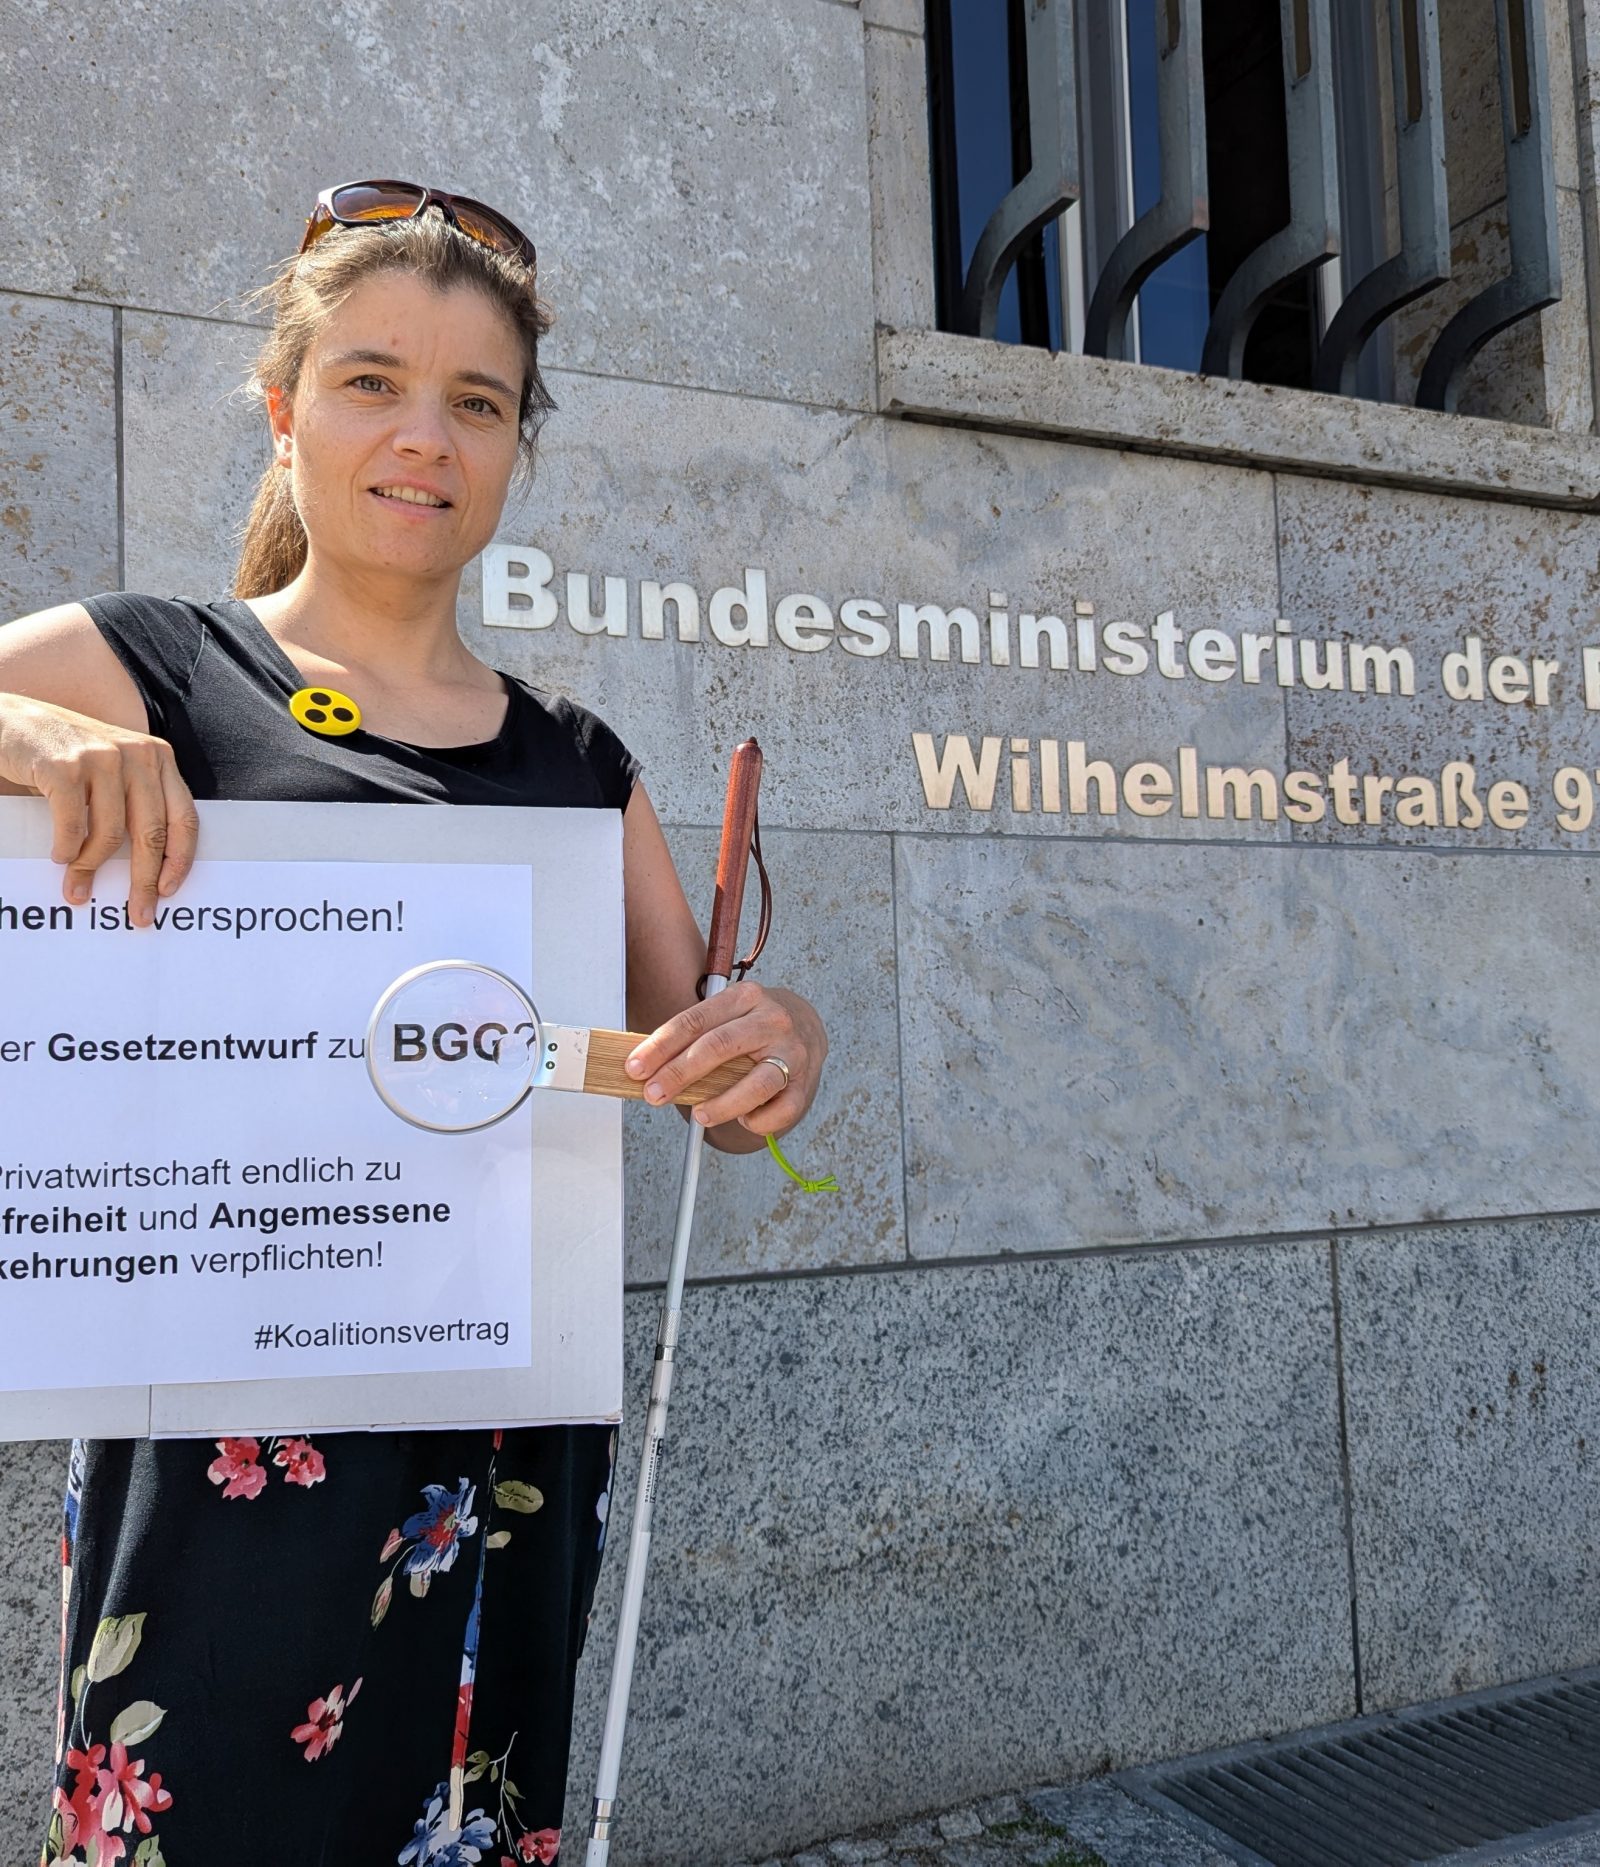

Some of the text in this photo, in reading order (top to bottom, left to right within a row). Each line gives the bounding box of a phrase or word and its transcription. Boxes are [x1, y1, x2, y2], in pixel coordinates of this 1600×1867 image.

[481, 543, 1415, 697] Bundesministerium
[1441, 635, 1560, 707] der
[911, 732, 1600, 833] Wilhelmstraße 9
[89, 897, 134, 931] ist
[153, 898, 404, 940] versprochen!
[47, 1030, 319, 1062] Gesetzentwurf
[0, 1155, 402, 1190] rivatwirtschaft endlich zu
[0, 1201, 451, 1235] freiheit und Angemessene
[190, 1240, 384, 1279] verpflichten!
[254, 1318, 510, 1350] #Koalitionsvertrag
